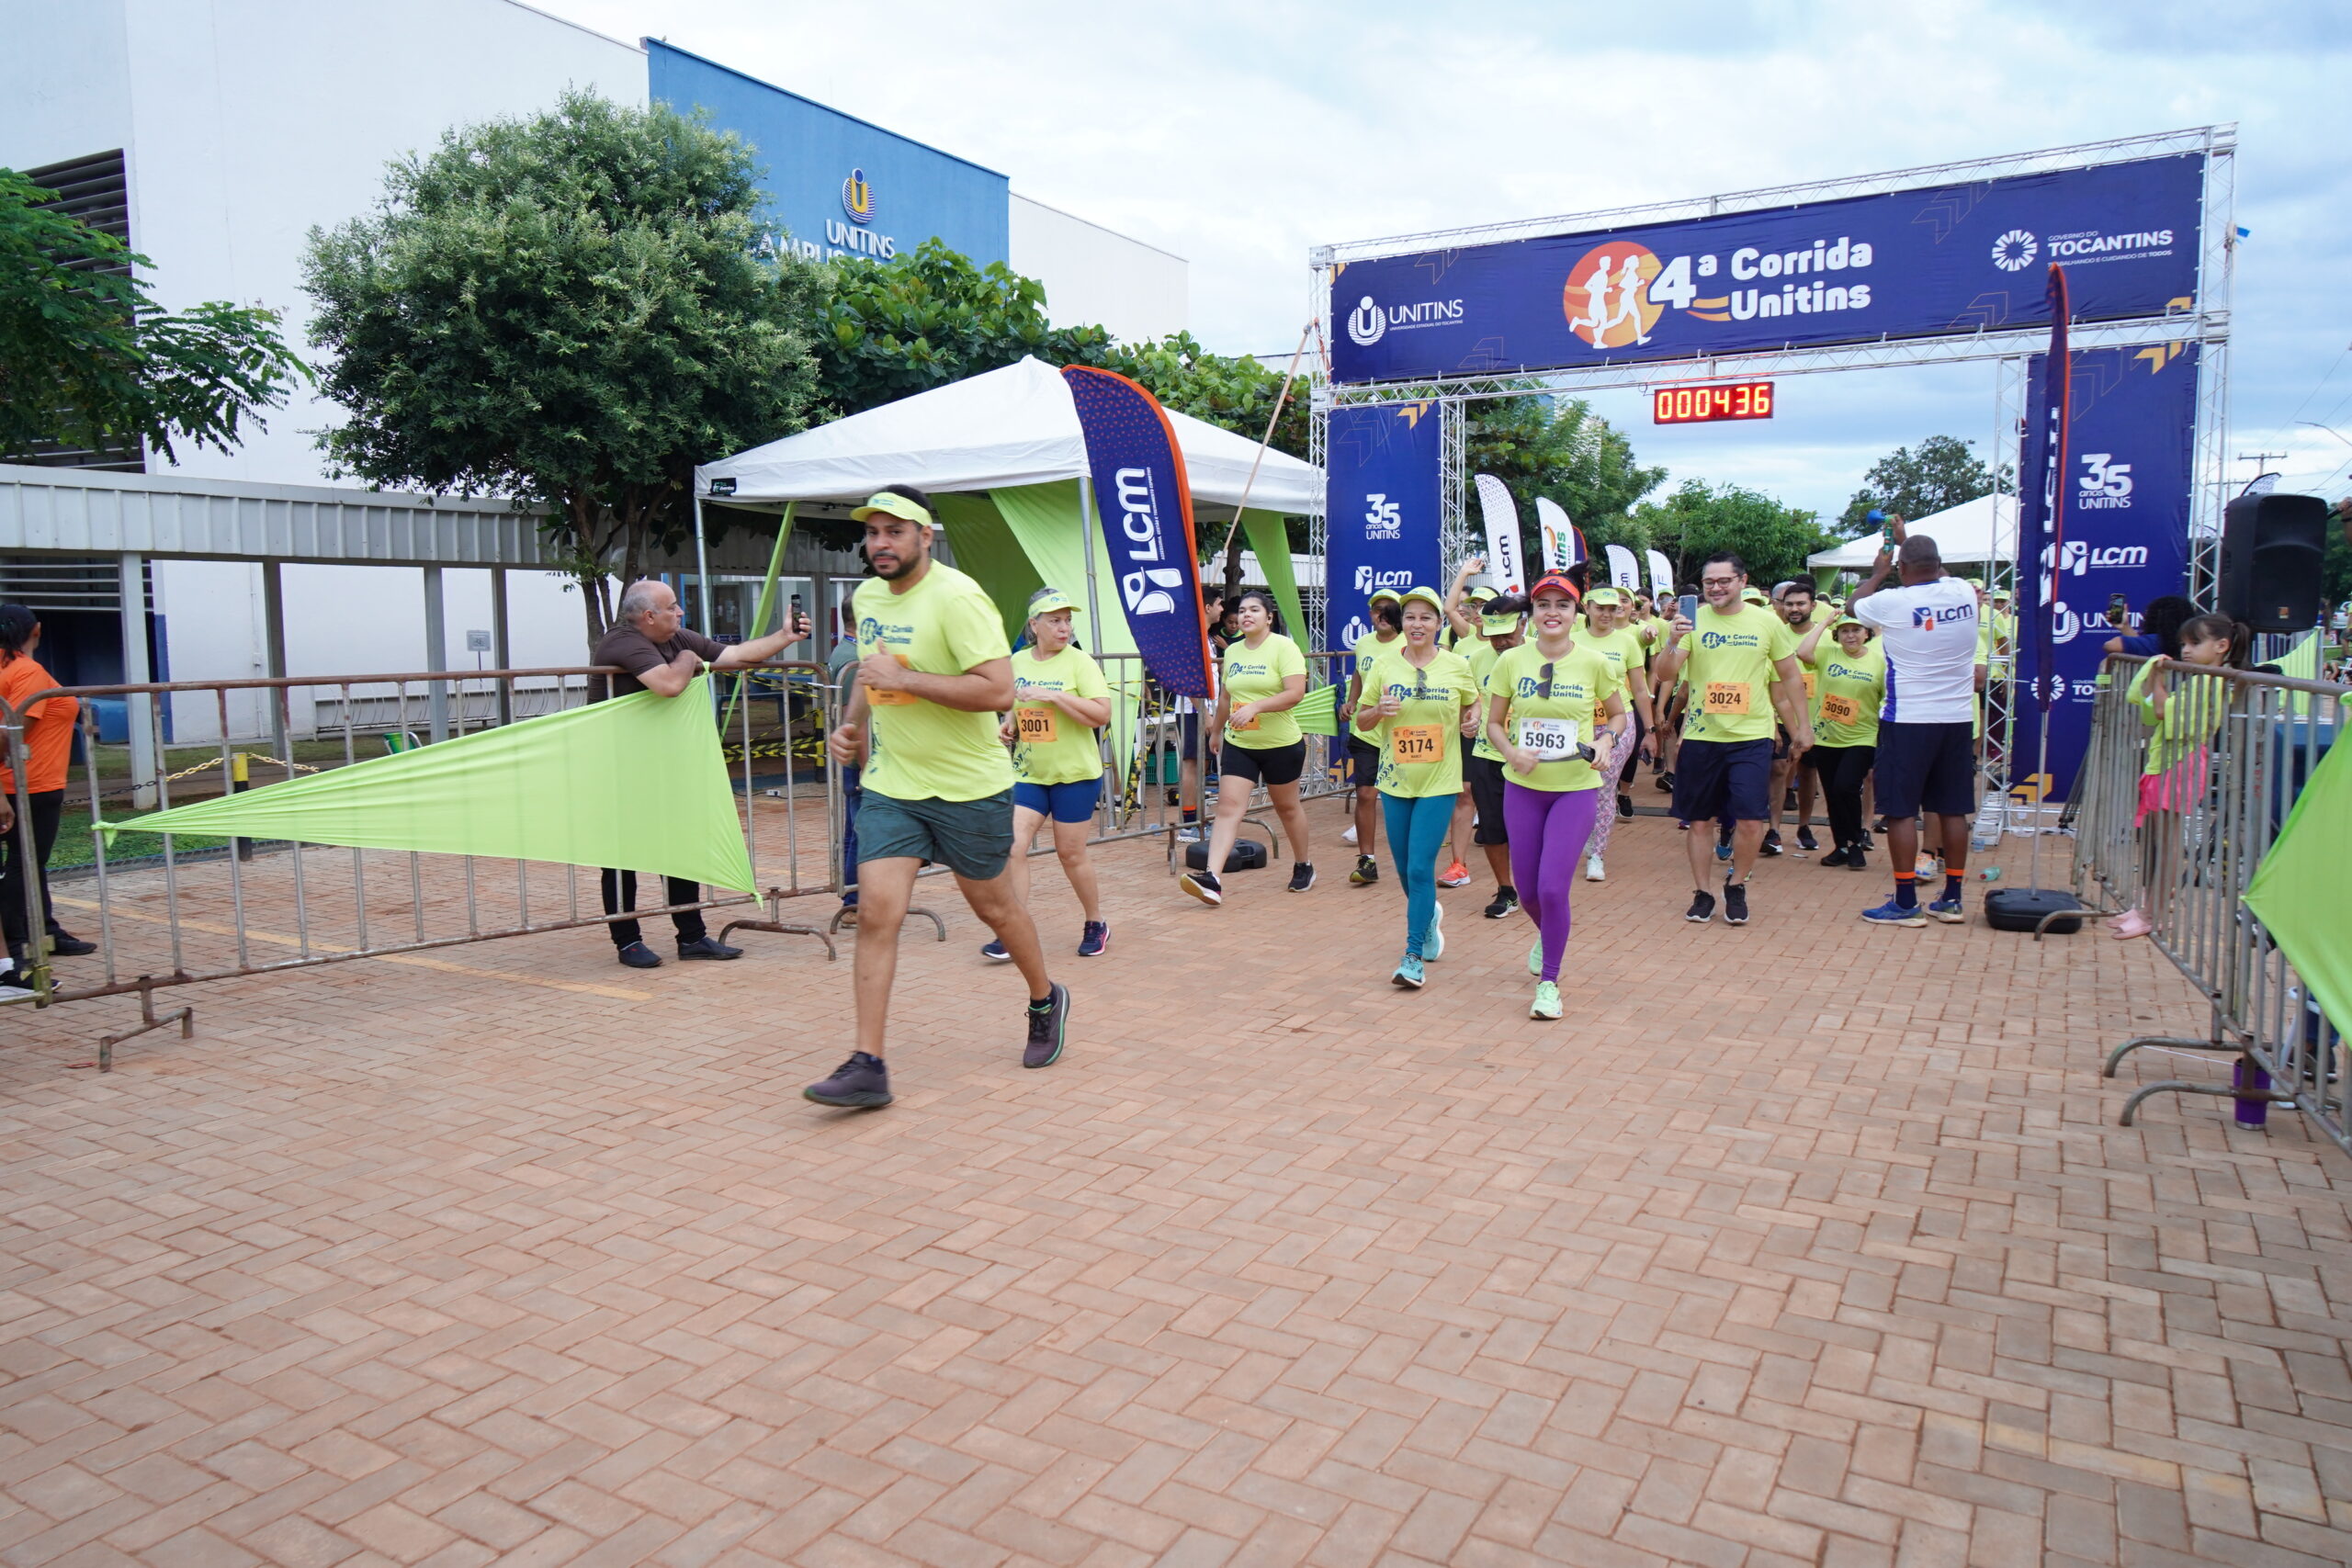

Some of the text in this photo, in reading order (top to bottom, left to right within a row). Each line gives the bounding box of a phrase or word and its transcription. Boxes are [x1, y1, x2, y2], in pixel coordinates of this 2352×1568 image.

[826, 219, 896, 259] UNITINS
[2047, 230, 2173, 257] TOCANTINS
[2048, 231, 2085, 242] GOVERNO
[1649, 236, 1872, 309] 4ª Corrida
[1731, 280, 1871, 321] Unitins
[1389, 299, 1464, 324] UNITINS
[1657, 386, 1770, 419] 000436
[2078, 453, 2133, 498] 35
[2078, 490, 2105, 498] anos
[1365, 493, 1401, 530] 35
[2079, 496, 2132, 510] UNITINS
[1365, 529, 1401, 540] UNITINS
[1553, 691, 1583, 699] Unitins
[1709, 692, 1741, 705] 3024
[1825, 701, 1850, 716] 3090
[1021, 718, 1049, 733] 3001
[1398, 738, 1434, 754] 3174
[1525, 731, 1566, 750] 5963
